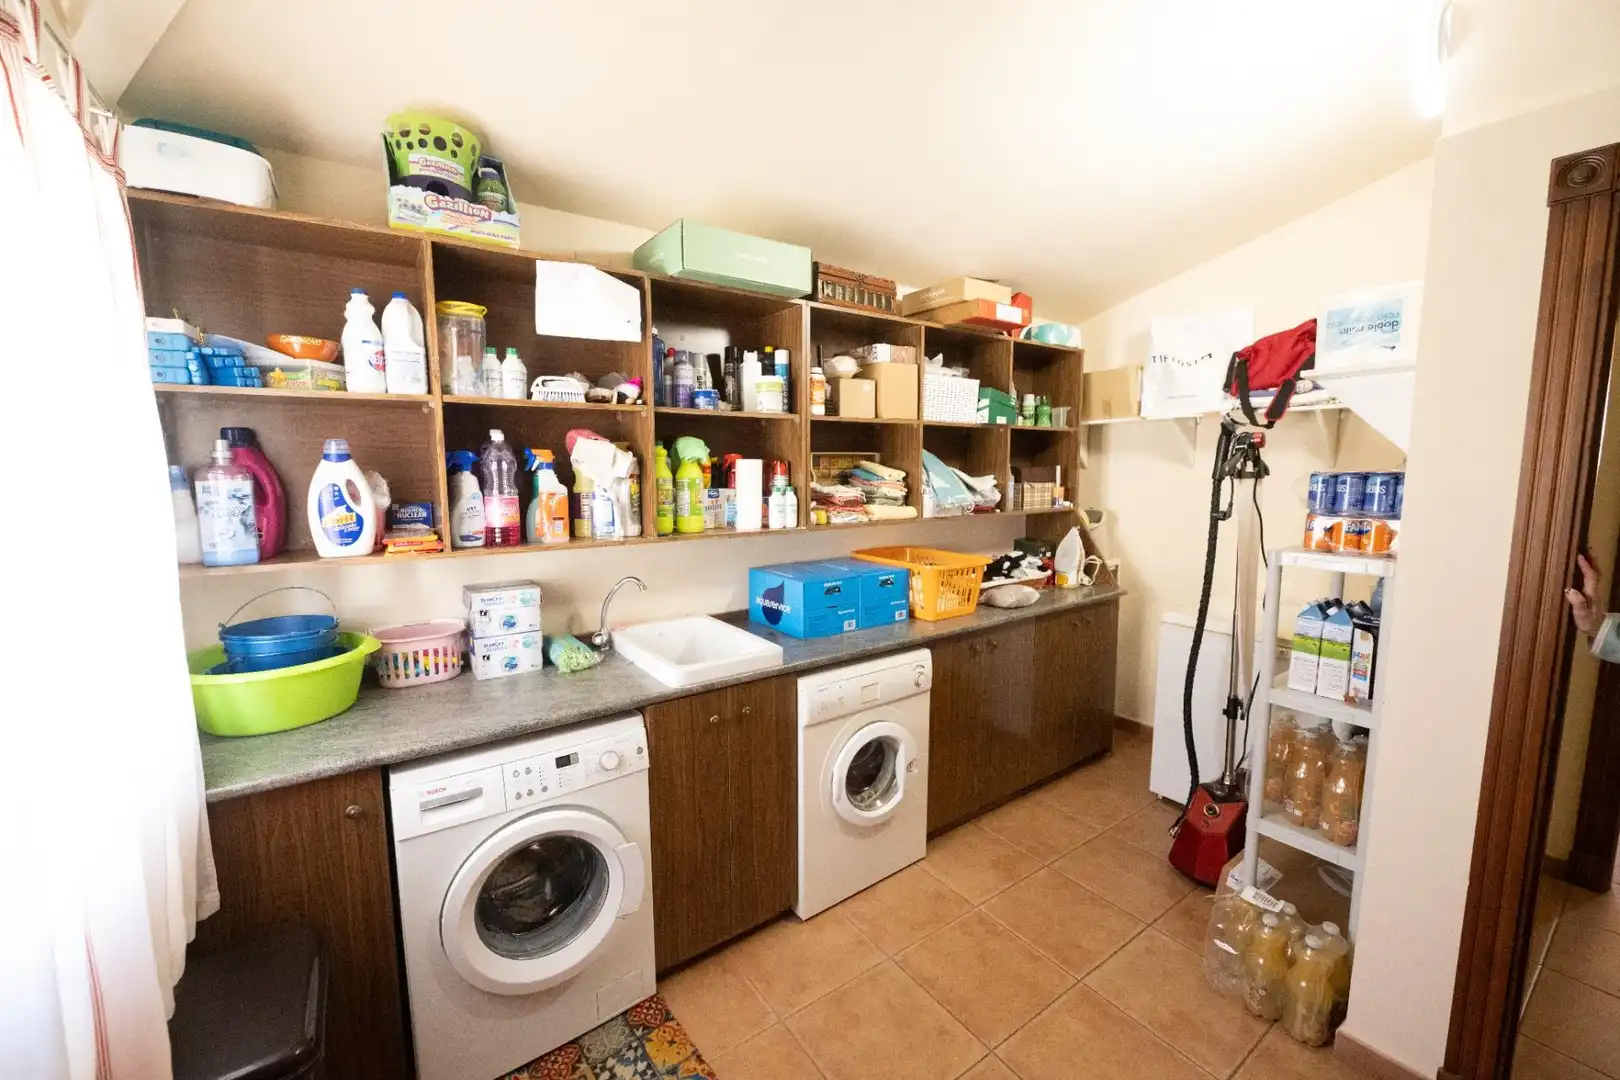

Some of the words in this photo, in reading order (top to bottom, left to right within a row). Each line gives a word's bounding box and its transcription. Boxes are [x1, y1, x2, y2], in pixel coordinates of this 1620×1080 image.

[396, 511, 428, 519] NUCLEAR
[1346, 521, 1372, 532] FANTA
[756, 596, 791, 613] aquaservice
[427, 787, 447, 795] BOSCH
